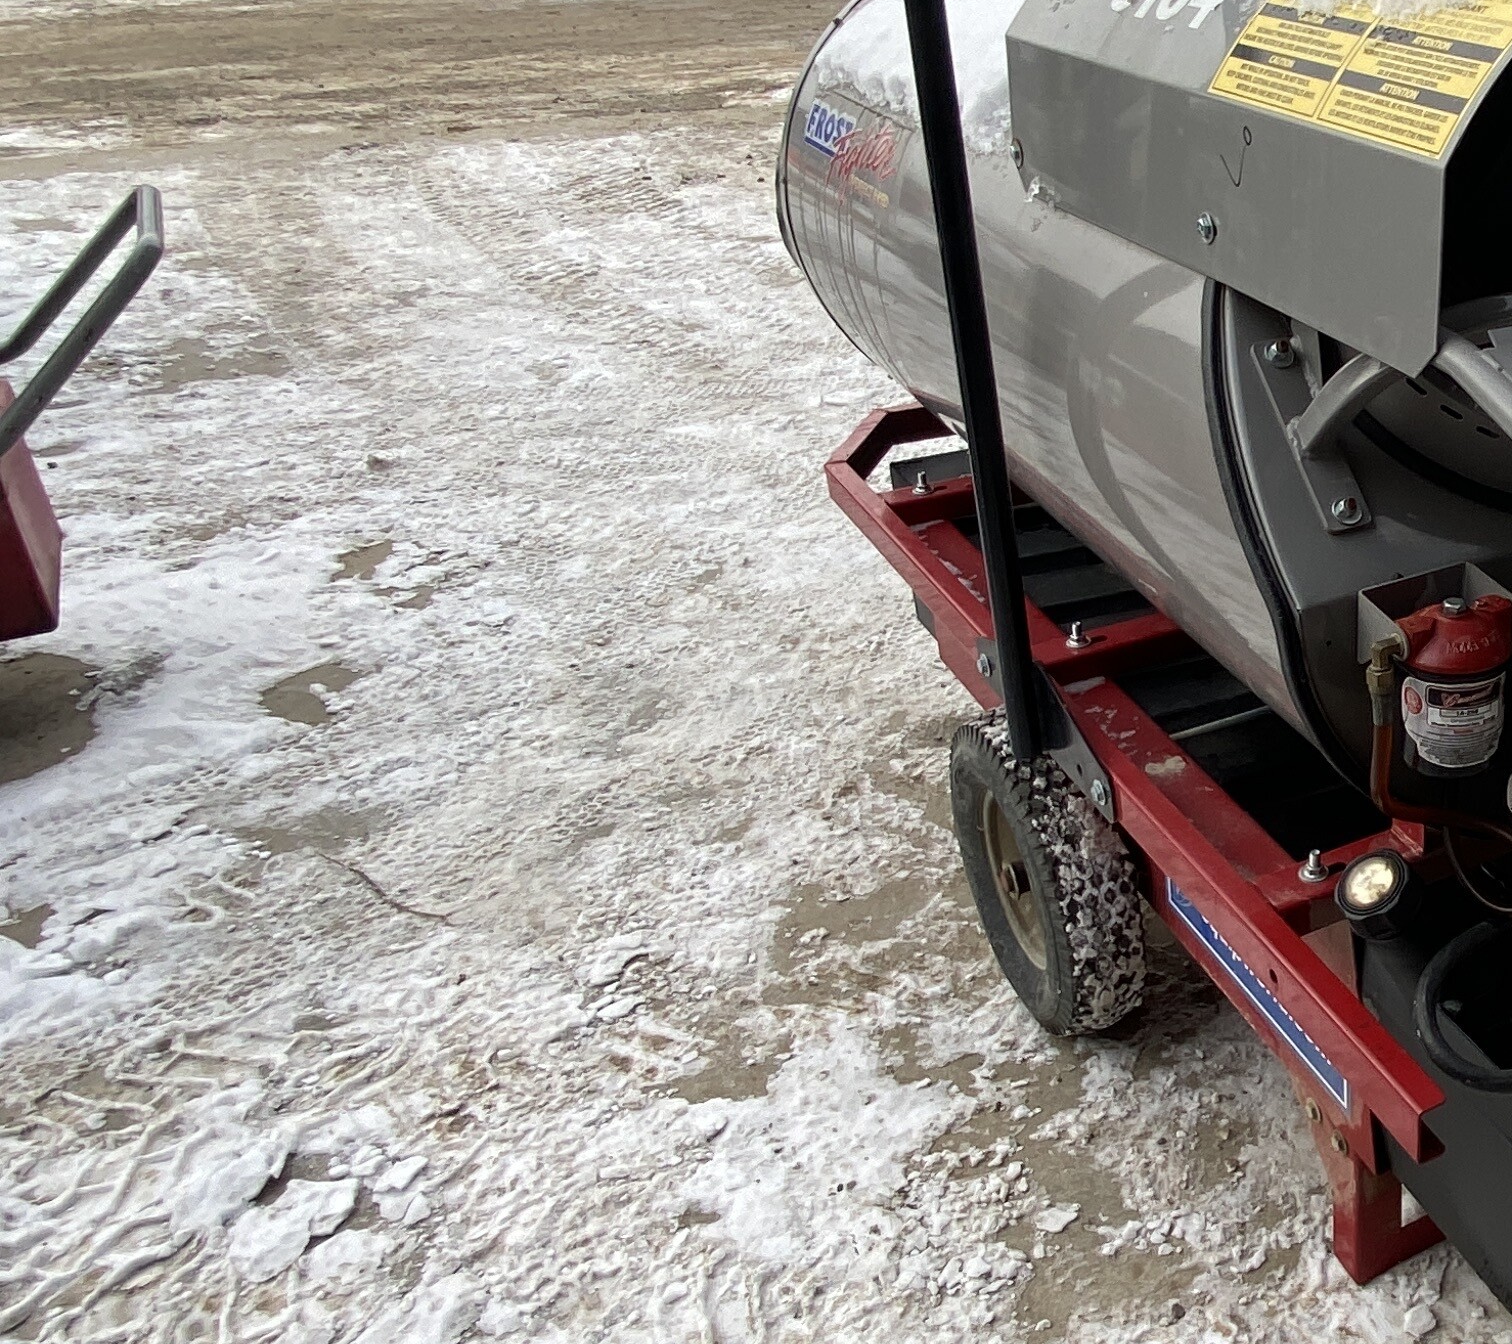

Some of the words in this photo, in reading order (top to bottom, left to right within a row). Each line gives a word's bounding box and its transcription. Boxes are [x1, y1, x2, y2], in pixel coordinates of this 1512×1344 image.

[1412, 35, 1454, 51] ATTENTION
[1380, 82, 1420, 100] ATTENTION
[805, 102, 856, 150] FROST
